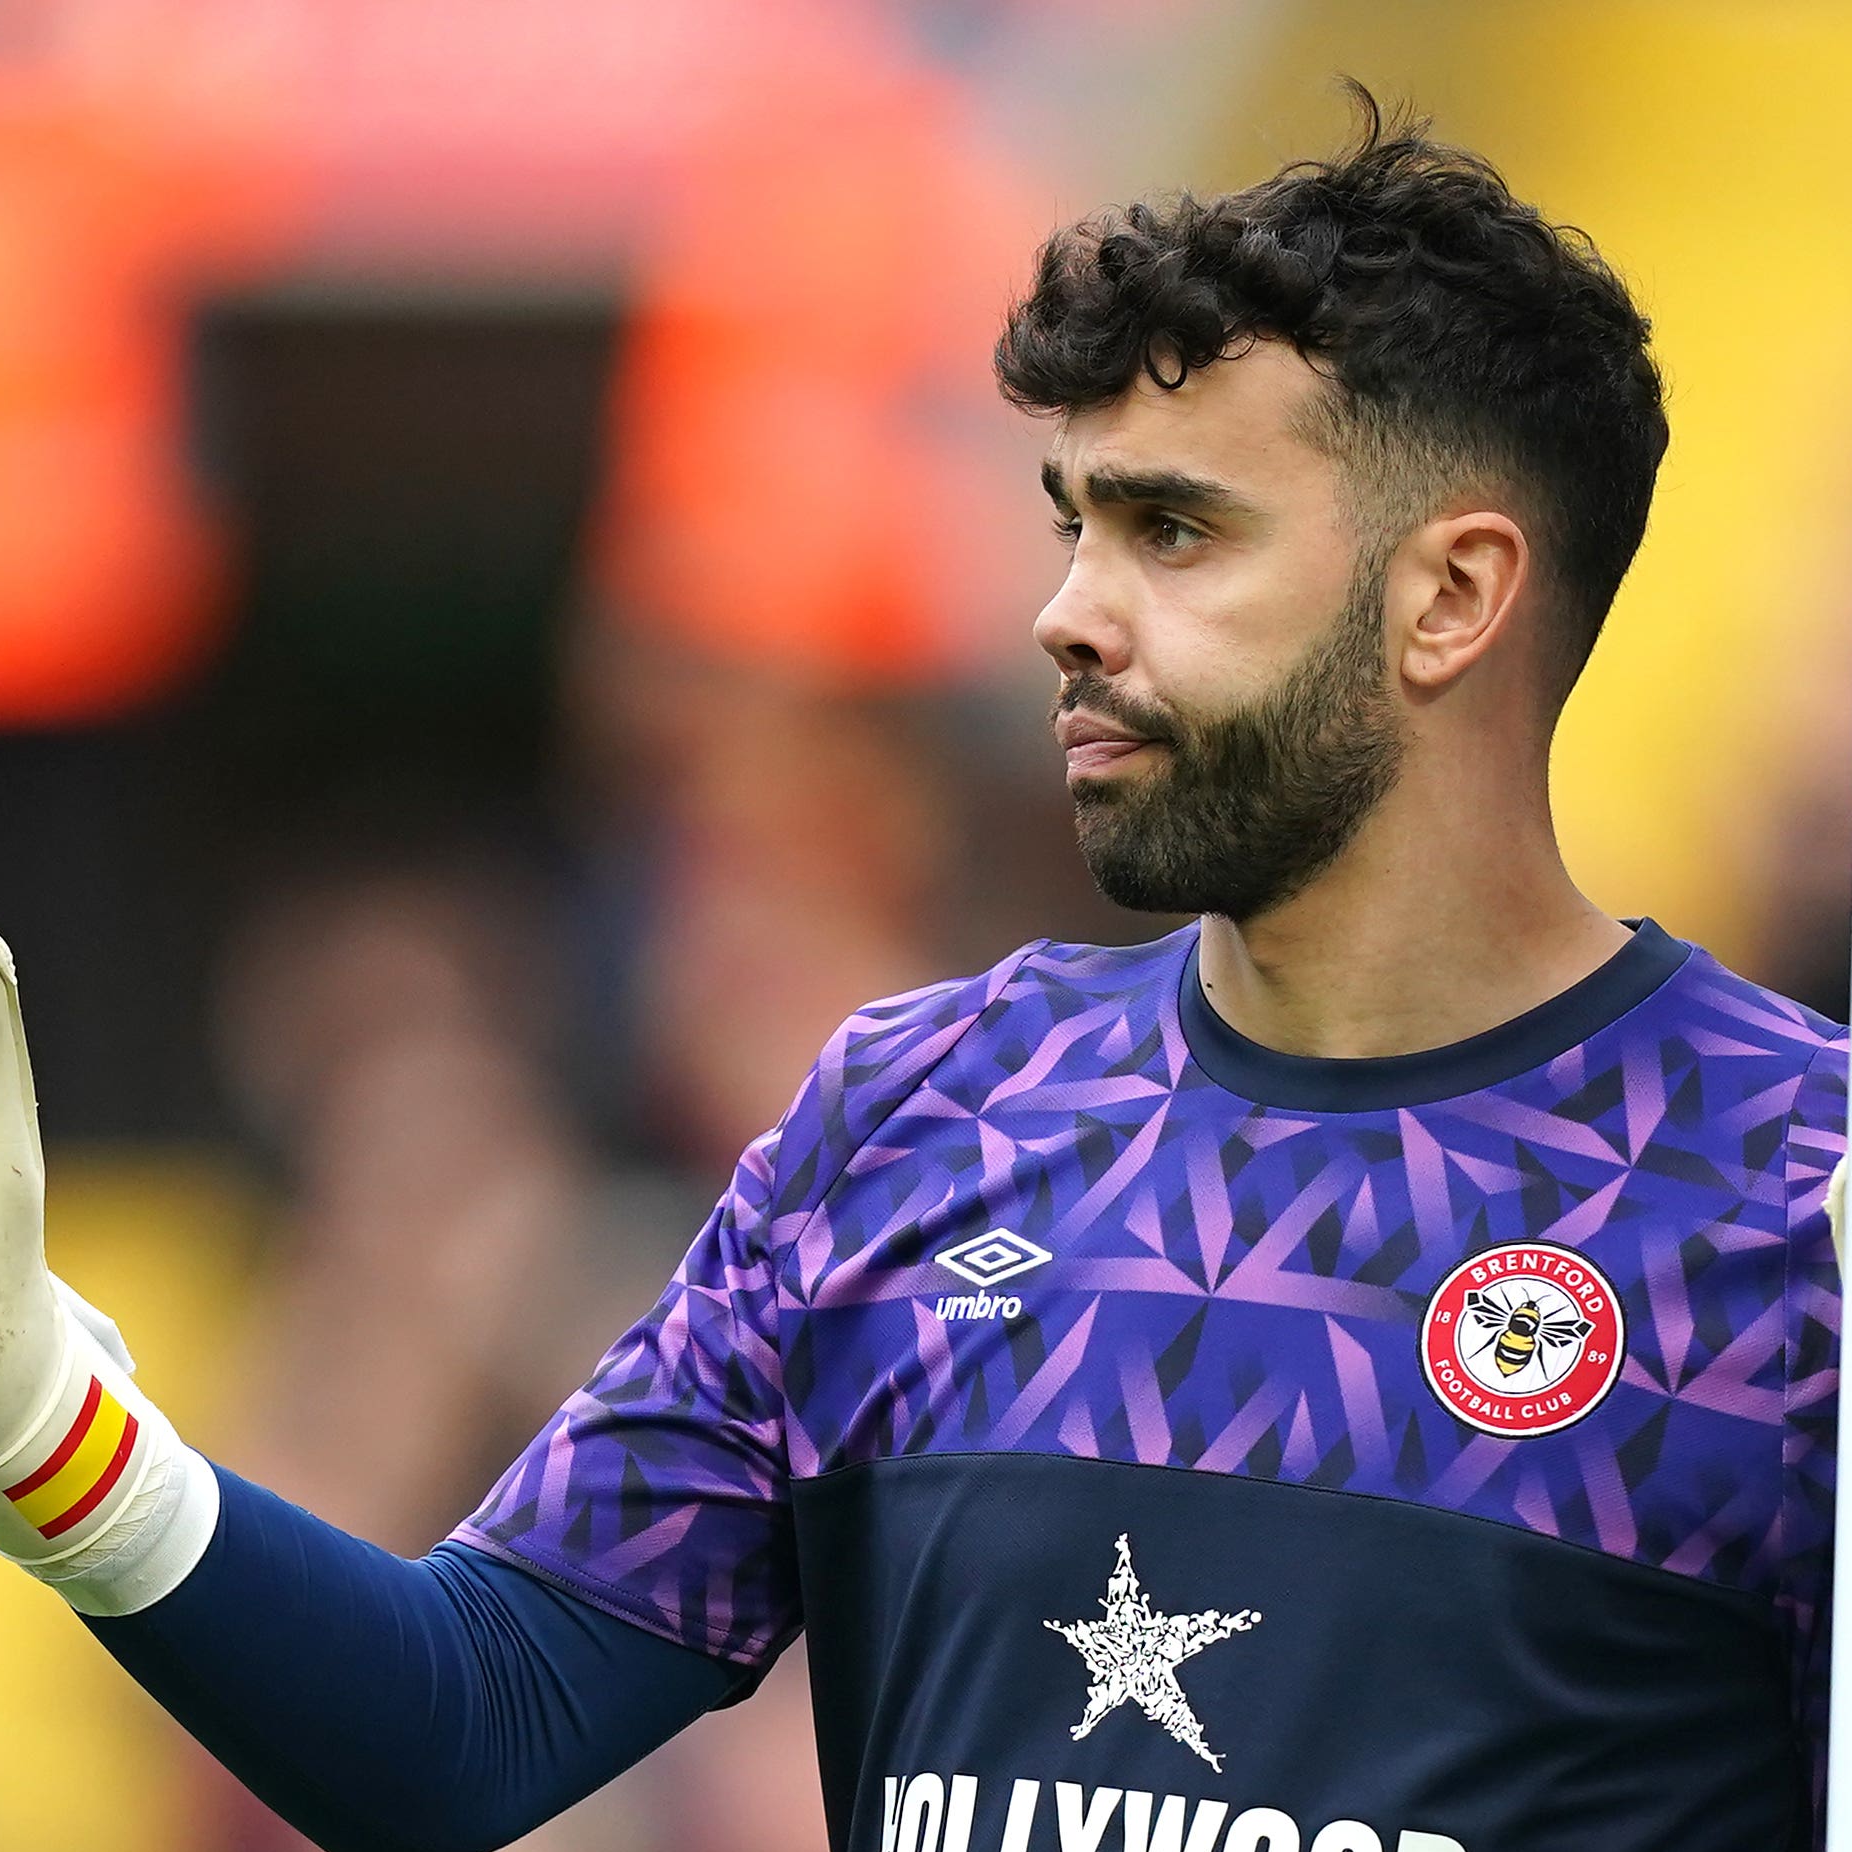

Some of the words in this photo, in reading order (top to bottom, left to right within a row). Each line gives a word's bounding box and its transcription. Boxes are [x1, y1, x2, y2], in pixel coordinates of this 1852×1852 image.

[1470, 1253, 1604, 1313] BRENTFORD
[935, 1289, 1022, 1321] umbro
[1435, 1310, 1452, 1324] 18
[1587, 1350, 1608, 1365] 89
[1435, 1359, 1514, 1420] FOOTBALL
[1521, 1392, 1573, 1418] CLUB
